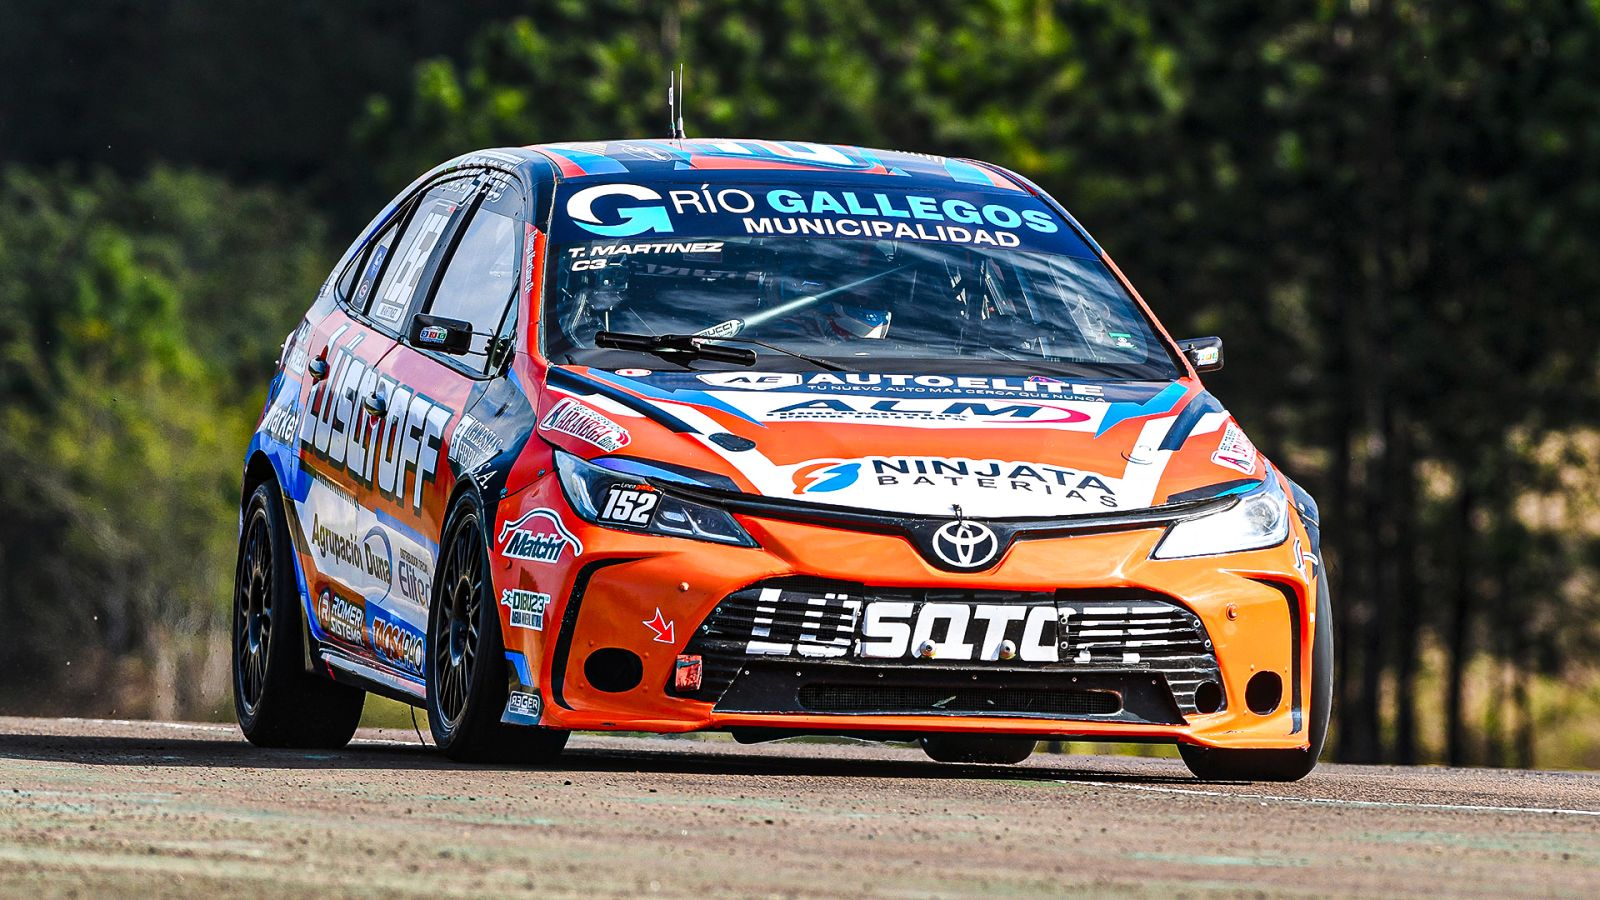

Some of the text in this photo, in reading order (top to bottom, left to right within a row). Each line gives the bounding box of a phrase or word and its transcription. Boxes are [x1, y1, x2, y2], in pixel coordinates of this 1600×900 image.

[669, 183, 1059, 234] RÍO GALLEGOS
[742, 216, 1021, 248] MUNICIPALIDAD
[568, 241, 725, 259] T. MARTINEZ
[807, 373, 1105, 397] AUTOELITE
[965, 389, 1016, 397] CERCA
[1052, 394, 1106, 404] NUNCA
[769, 400, 1043, 418] ALM
[872, 459, 1115, 496] NINJATA
[877, 475, 1118, 508] BATERIAS
[601, 489, 658, 524] 152
[311, 513, 393, 585] Agrupación Duna
